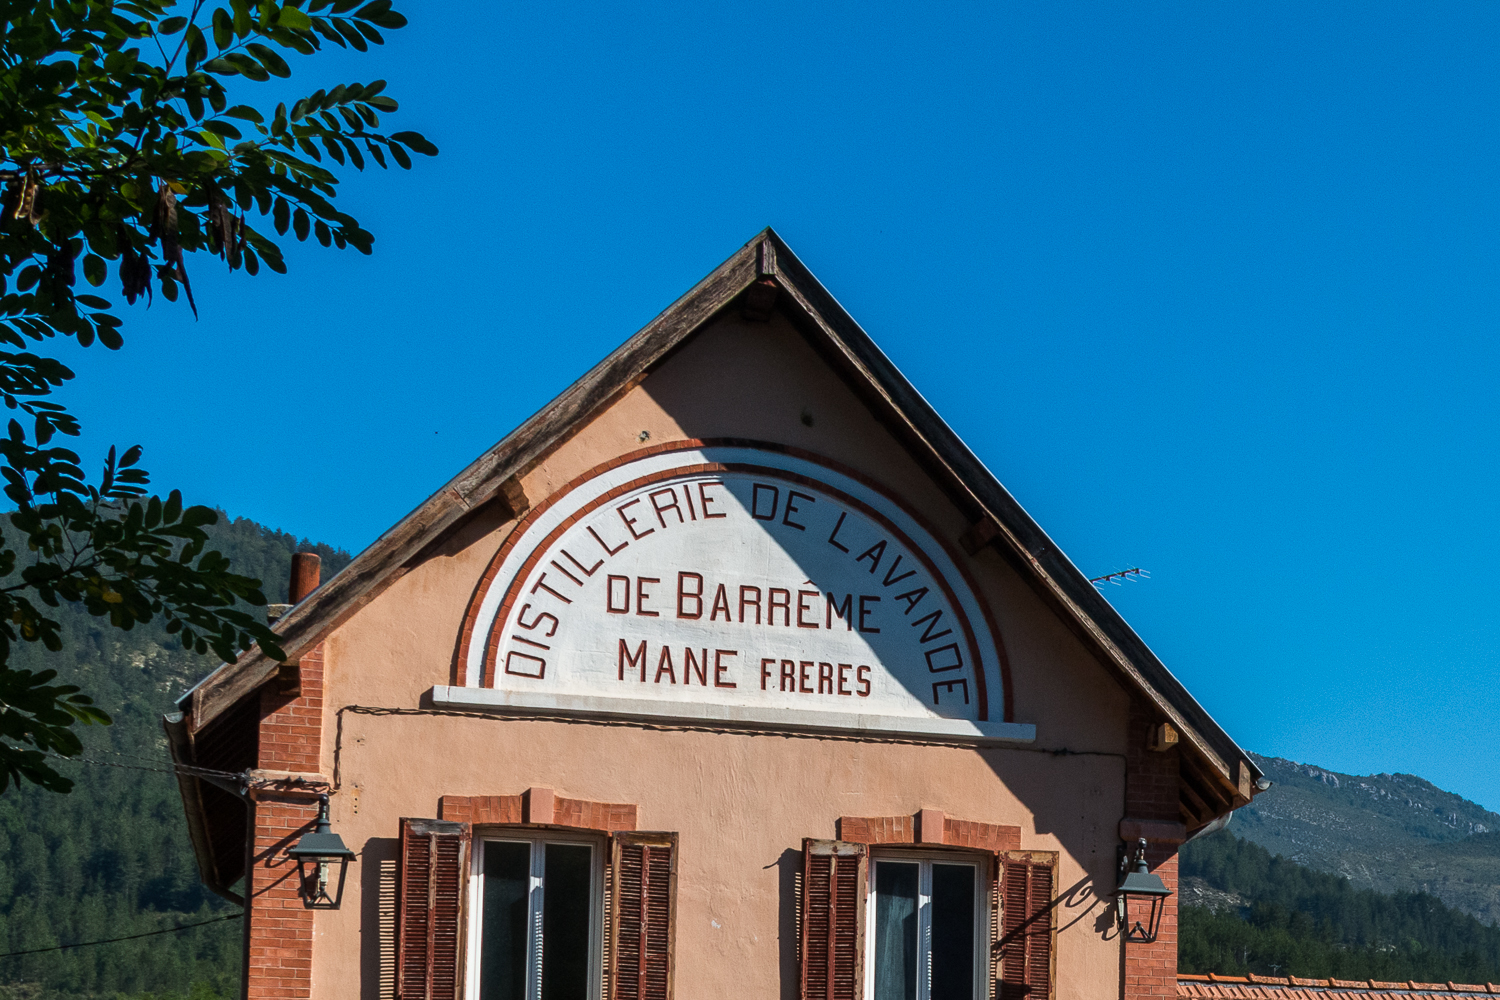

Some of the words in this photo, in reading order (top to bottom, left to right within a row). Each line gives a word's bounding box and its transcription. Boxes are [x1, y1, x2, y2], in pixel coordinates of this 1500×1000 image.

[504, 481, 728, 680] DISTILLERIE
[751, 482, 817, 531] DE
[827, 511, 970, 706] LAVANDE
[606, 573, 661, 618] DE
[617, 637, 739, 689] MANE
[760, 657, 872, 698] FRERES
